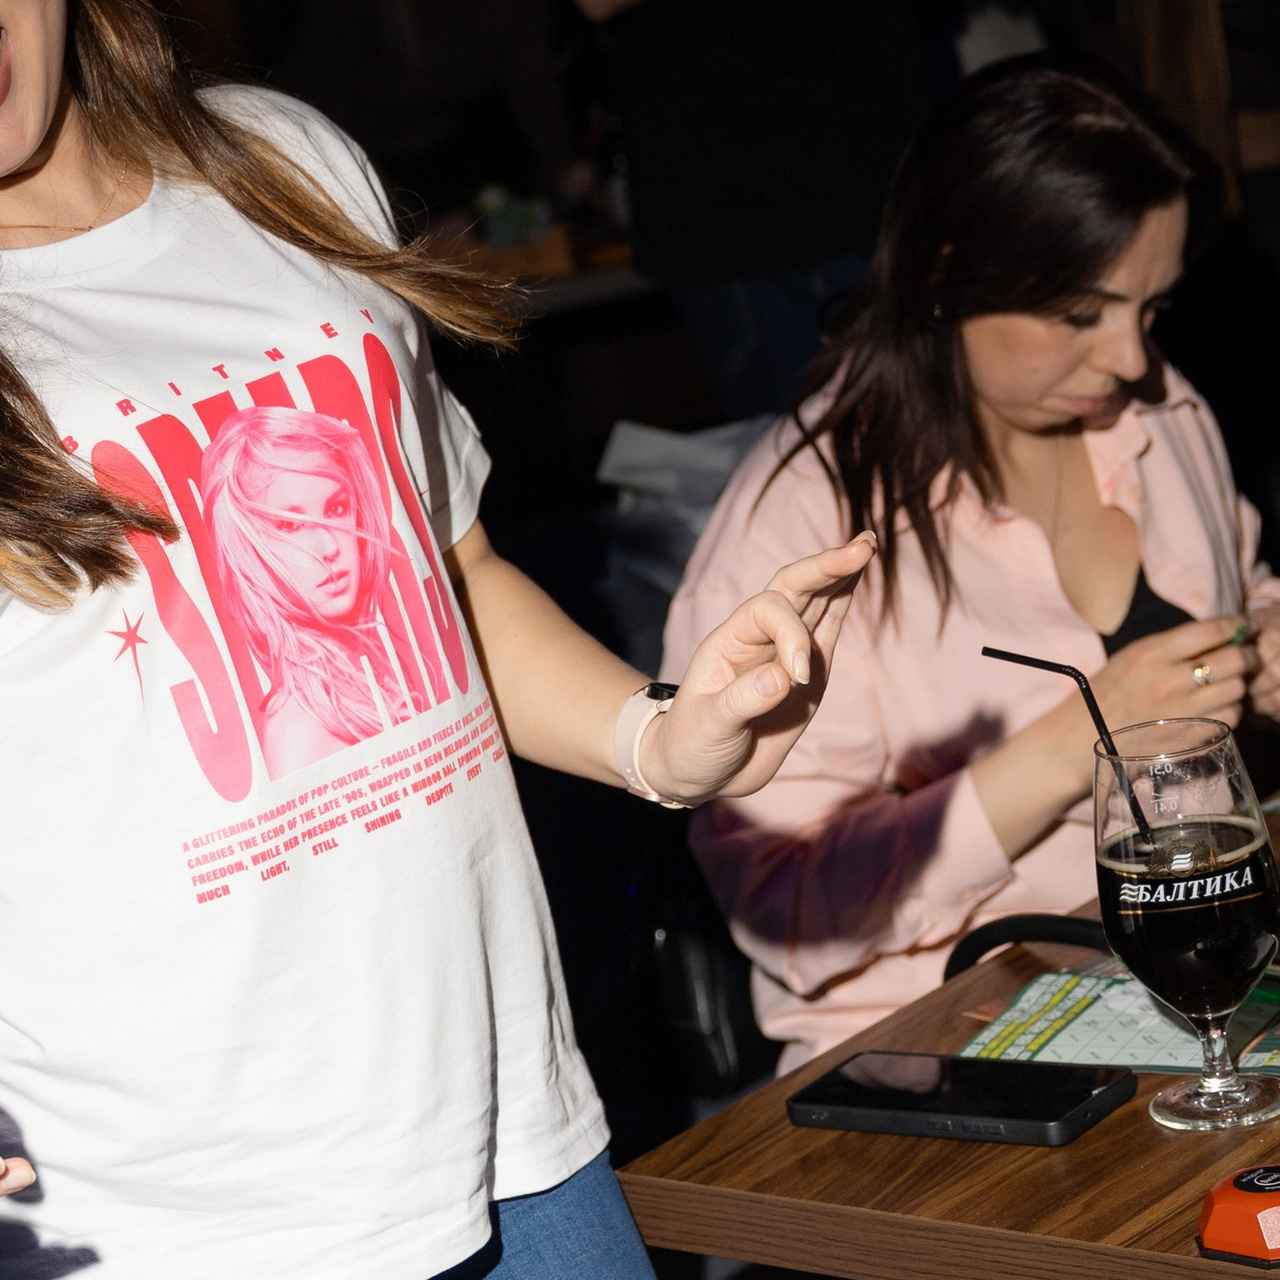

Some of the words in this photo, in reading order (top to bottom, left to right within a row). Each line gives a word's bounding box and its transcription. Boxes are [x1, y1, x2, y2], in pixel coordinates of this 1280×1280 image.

[58, 309, 375, 457] BRITNEY
[183, 842, 190, 853] A
[192, 818, 256, 849] GLITTERING
[257, 798, 298, 826] PARADOX
[298, 792, 309, 806] OF
[311, 784, 329, 800] POP
[331, 766, 371, 791] CULTURE
[380, 745, 417, 769] FRAGILE
[417, 737, 432, 753] AND
[432, 725, 455, 745] FIERCE
[187, 845, 235, 869] CARRIES
[237, 836, 259, 852] THE
[261, 824, 285, 844] ECHO
[287, 817, 298, 831] OF
[299, 808, 316, 825] THE
[318, 797, 341, 816] LATE
[368, 767, 411, 793] WRAPPED
[412, 762, 423, 775] IN
[423, 750, 443, 769] NEON
[442, 733, 471, 758] MELODIES
[191, 860, 249, 887] FREEDOM,
[250, 845, 281, 866] WHILE
[283, 835, 300, 852] HER
[301, 813, 349, 842] PRESENCE
[350, 800, 378, 821] FEELS
[379, 790, 401, 808] LIKE
[402, 786, 409, 798] A
[411, 770, 442, 794] MIRROR
[442, 761, 457, 779] BALL
[457, 744, 482, 769] SPINNING
[196, 884, 231, 904] MUCH
[260, 860, 290, 882] LIGHT,
[312, 837, 339, 856] STILL
[364, 808, 402, 834] SHINING
[425, 782, 454, 807] DESPITE
[466, 762, 482, 782] EVERY
[1137, 866, 1254, 903] БАЛТИКА
